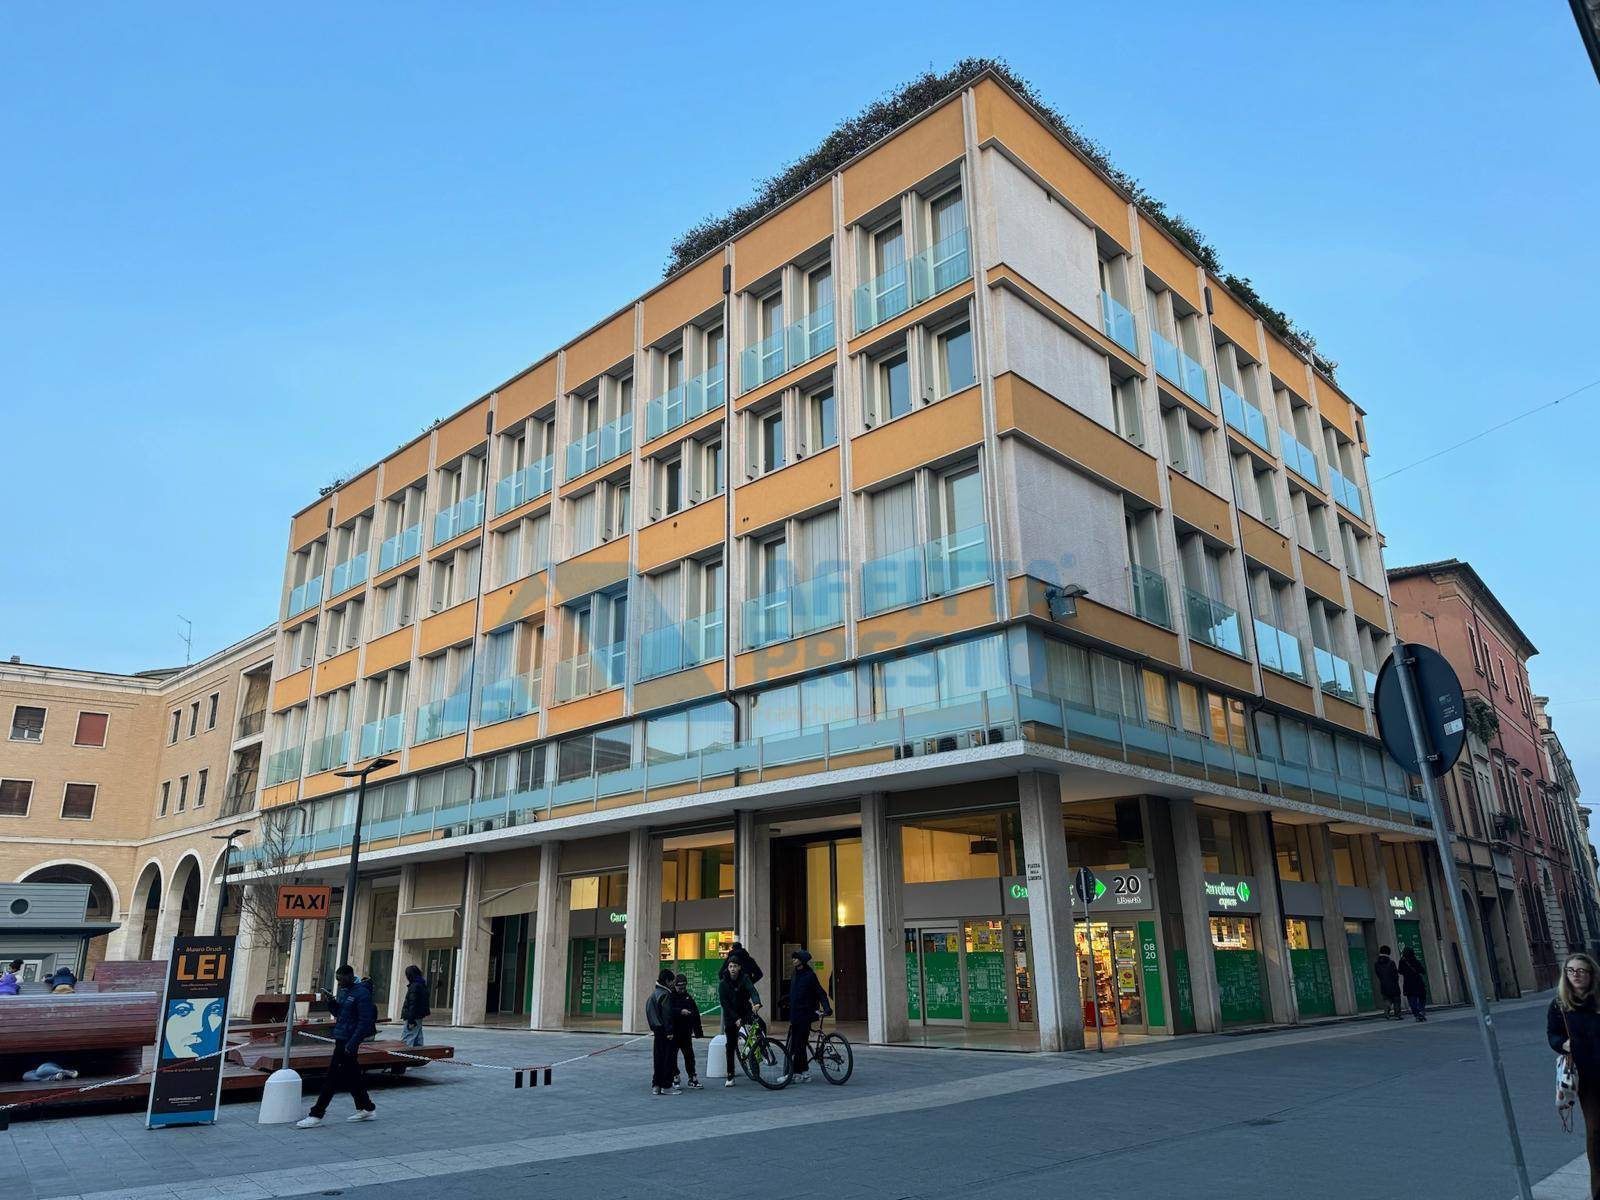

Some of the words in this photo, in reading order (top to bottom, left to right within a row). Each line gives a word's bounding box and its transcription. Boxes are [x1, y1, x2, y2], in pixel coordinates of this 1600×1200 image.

[1113, 875, 1141, 895] 20
[283, 894, 326, 909] TAXI
[1143, 943, 1156, 951] 08
[1145, 951, 1157, 960] 20
[176, 954, 227, 981] LEI
